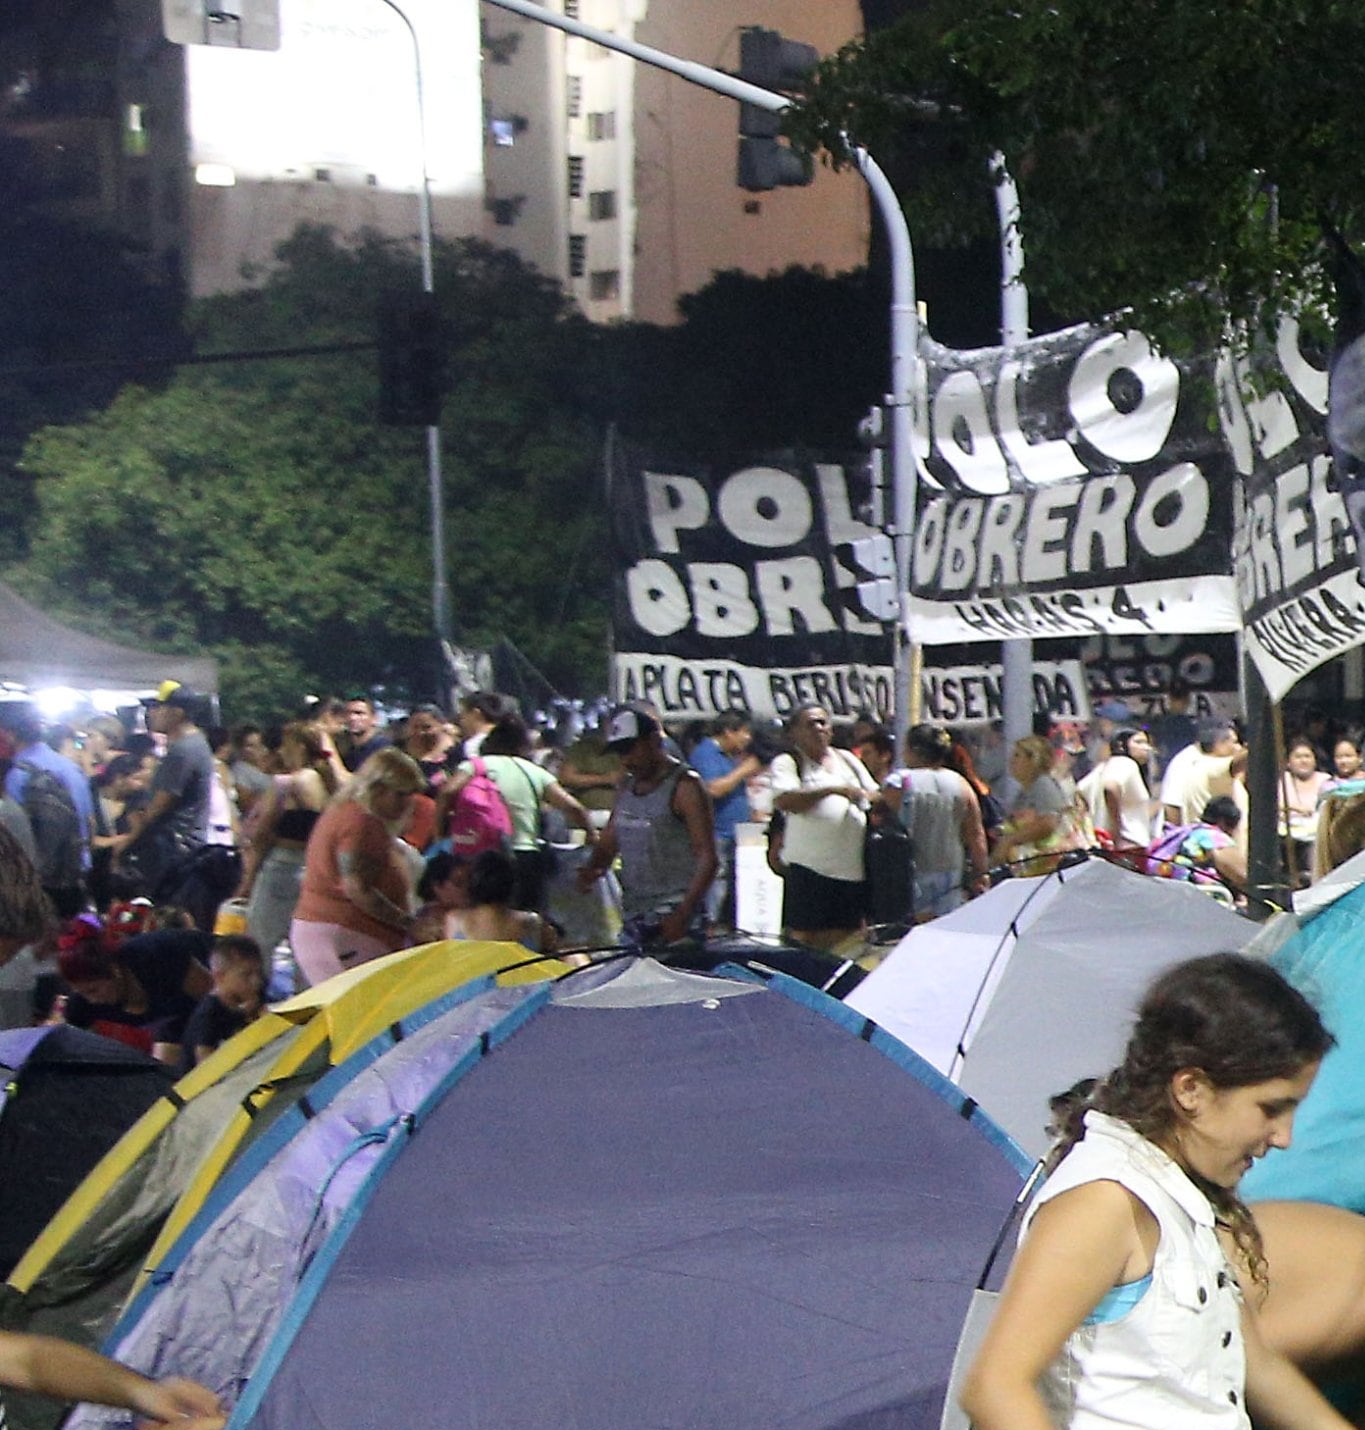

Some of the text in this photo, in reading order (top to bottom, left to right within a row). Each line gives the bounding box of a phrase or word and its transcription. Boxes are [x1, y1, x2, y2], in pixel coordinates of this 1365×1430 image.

[643, 463, 883, 554] POL
[912, 462, 1211, 590] OBRERO
[627, 555, 884, 638] OBR
[769, 671, 893, 724] BERISSO
[922, 672, 1078, 721] NSENDA
